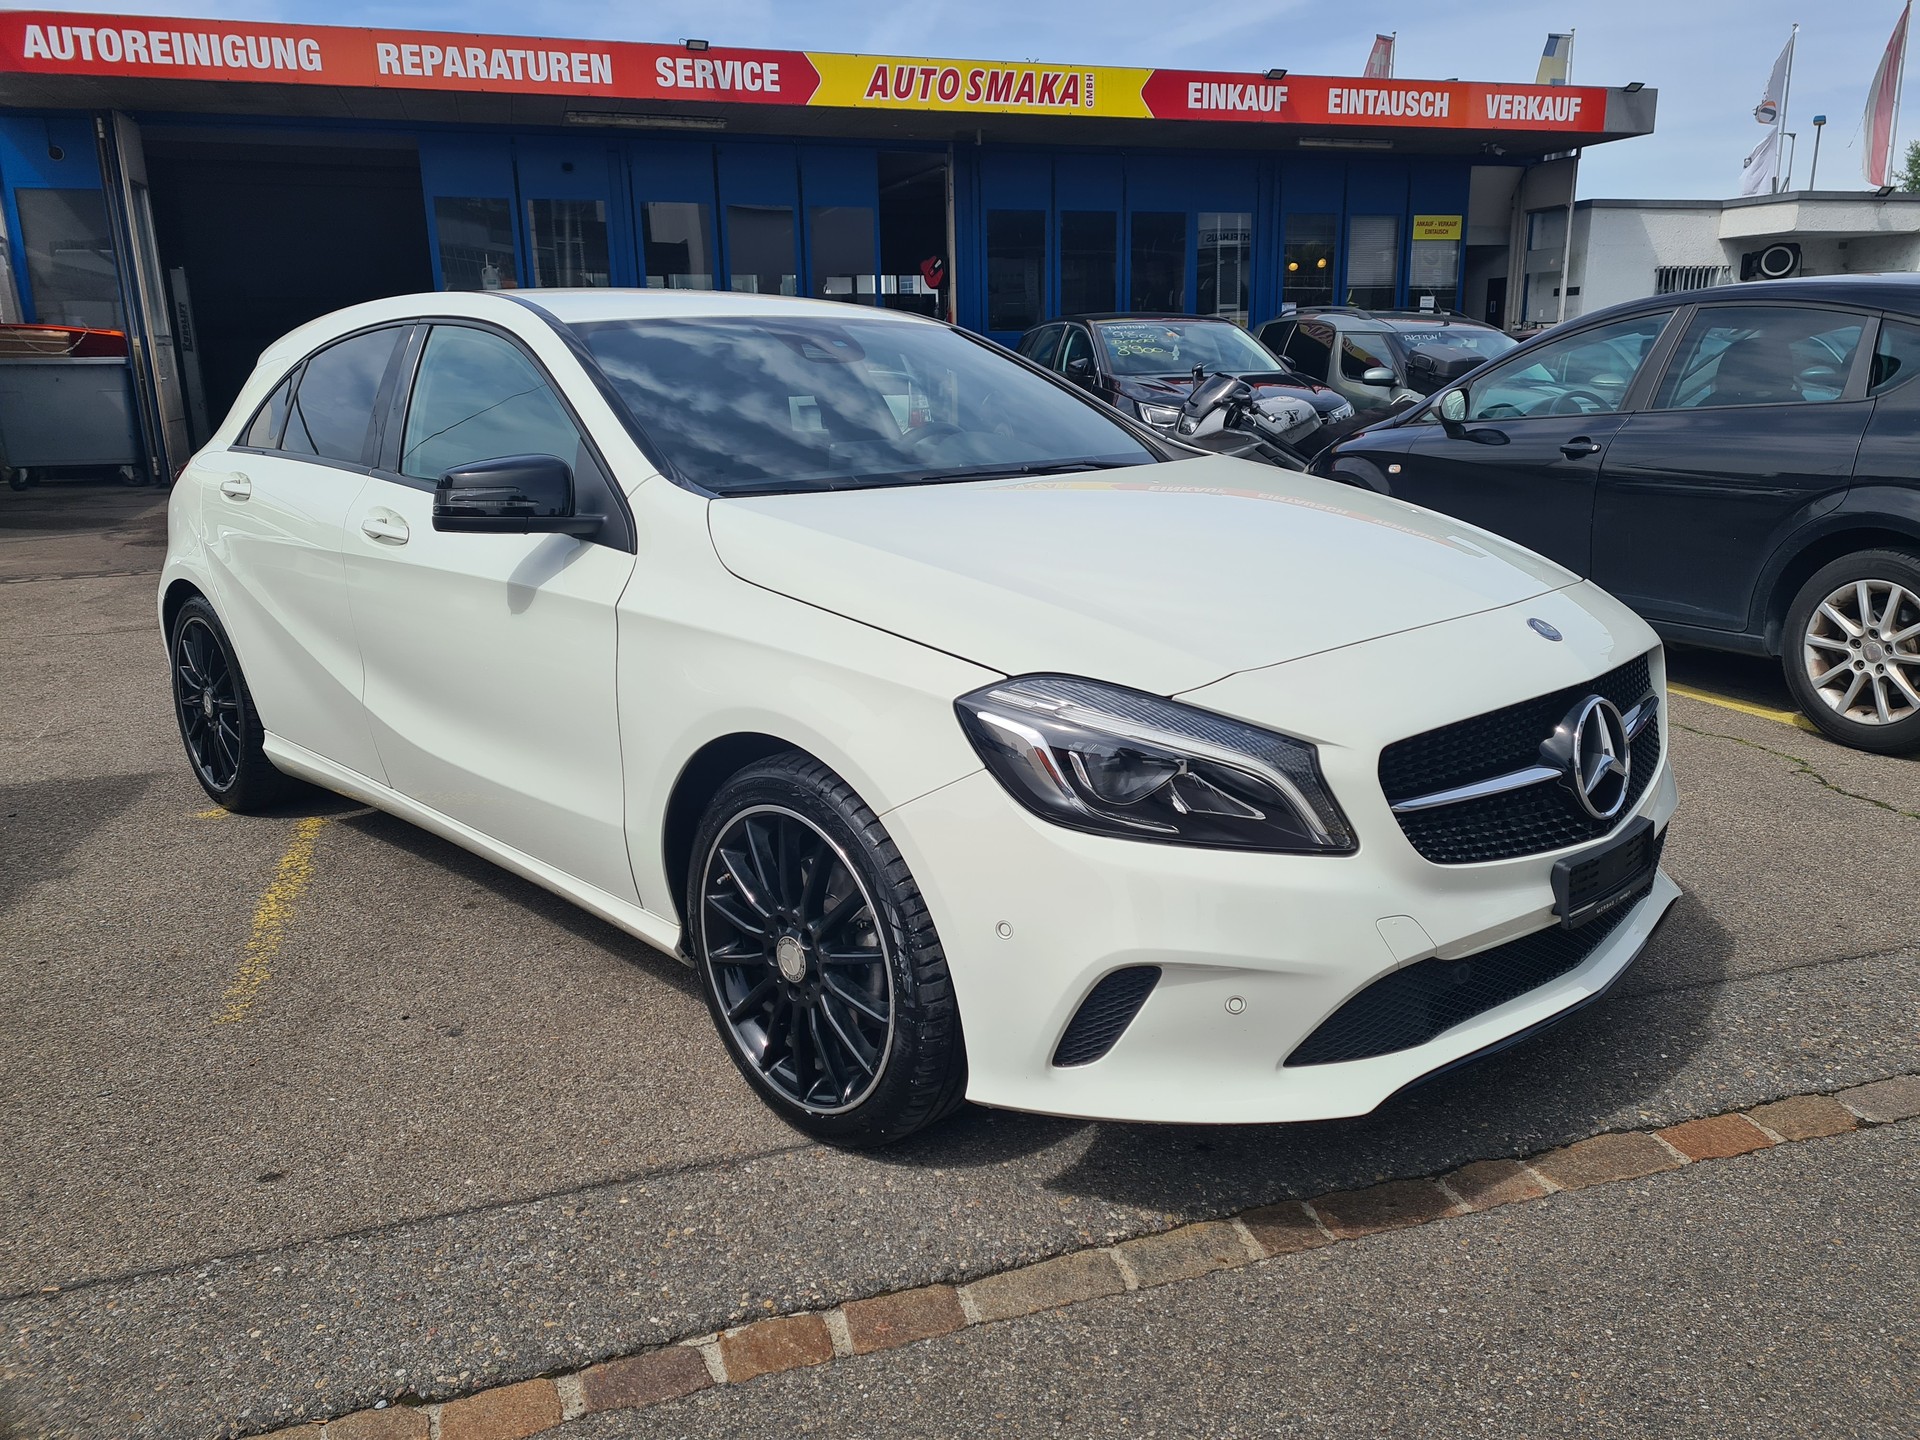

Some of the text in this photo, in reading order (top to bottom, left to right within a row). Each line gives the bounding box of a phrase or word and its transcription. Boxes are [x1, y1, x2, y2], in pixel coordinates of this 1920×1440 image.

[23, 24, 322, 72] AUTOREINIGUNG
[376, 42, 613, 84] REPARATUREN
[655, 56, 781, 92] SERVICE
[864, 65, 1080, 107] AUTO SMAKA
[1085, 73, 1094, 107] GMBH
[1188, 82, 1288, 112] EINKAUF
[1327, 88, 1449, 117] EINTAUSCH
[1486, 94, 1581, 122] VERKAUF
